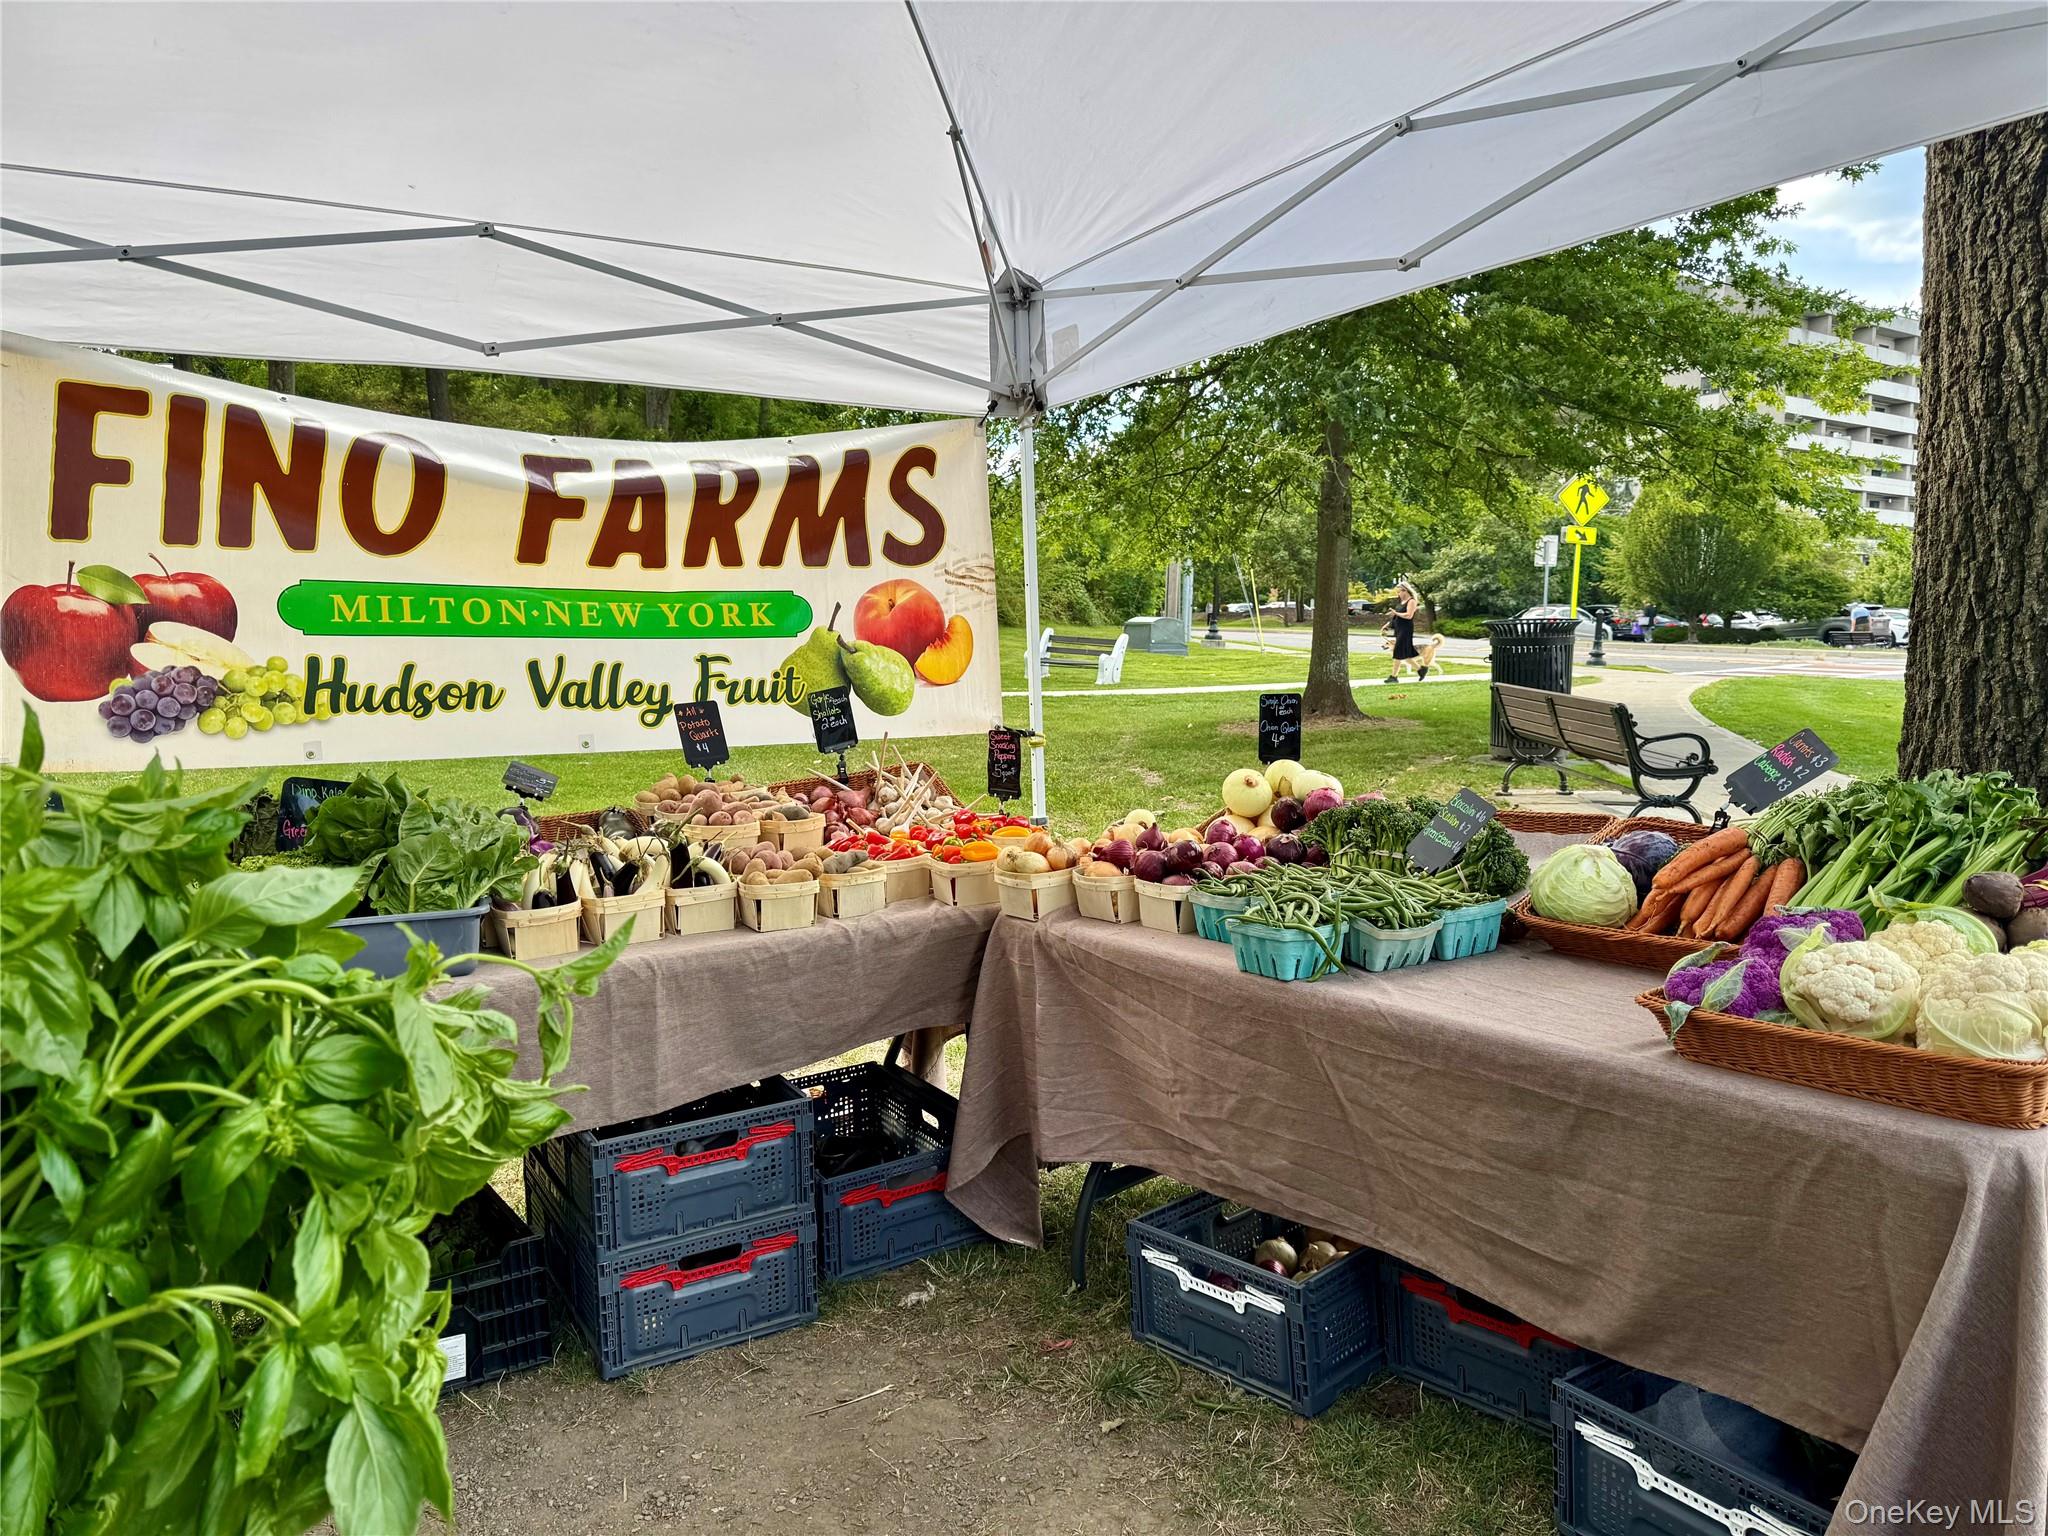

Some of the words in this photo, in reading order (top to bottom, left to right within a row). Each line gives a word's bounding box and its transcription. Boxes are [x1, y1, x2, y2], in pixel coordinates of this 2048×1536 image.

[47, 378, 448, 558] FINO
[514, 444, 947, 570] FARMS
[659, 601, 776, 628] YORK
[303, 654, 507, 719] Hudson
[525, 654, 676, 730] Valley
[694, 653, 806, 706] Fruit
[686, 706, 697, 717] All
[812, 705, 842, 721] Shallots
[679, 719, 711, 731] Potato
[830, 715, 848, 728] each
[1260, 720, 1279, 733] Onion
[689, 728, 720, 740] Quarts
[990, 731, 1011, 741] Sweet
[1788, 731, 1815, 759] Carrots
[1809, 754, 1829, 768] $3
[1770, 743, 1797, 769] Radish
[1792, 765, 1810, 780] $2
[1753, 753, 1782, 783] Cabbage
[1776, 777, 1793, 792] $3
[321, 786, 343, 798] Kale
[1475, 810, 1487, 823] $6
[1458, 821, 1472, 836] $2
